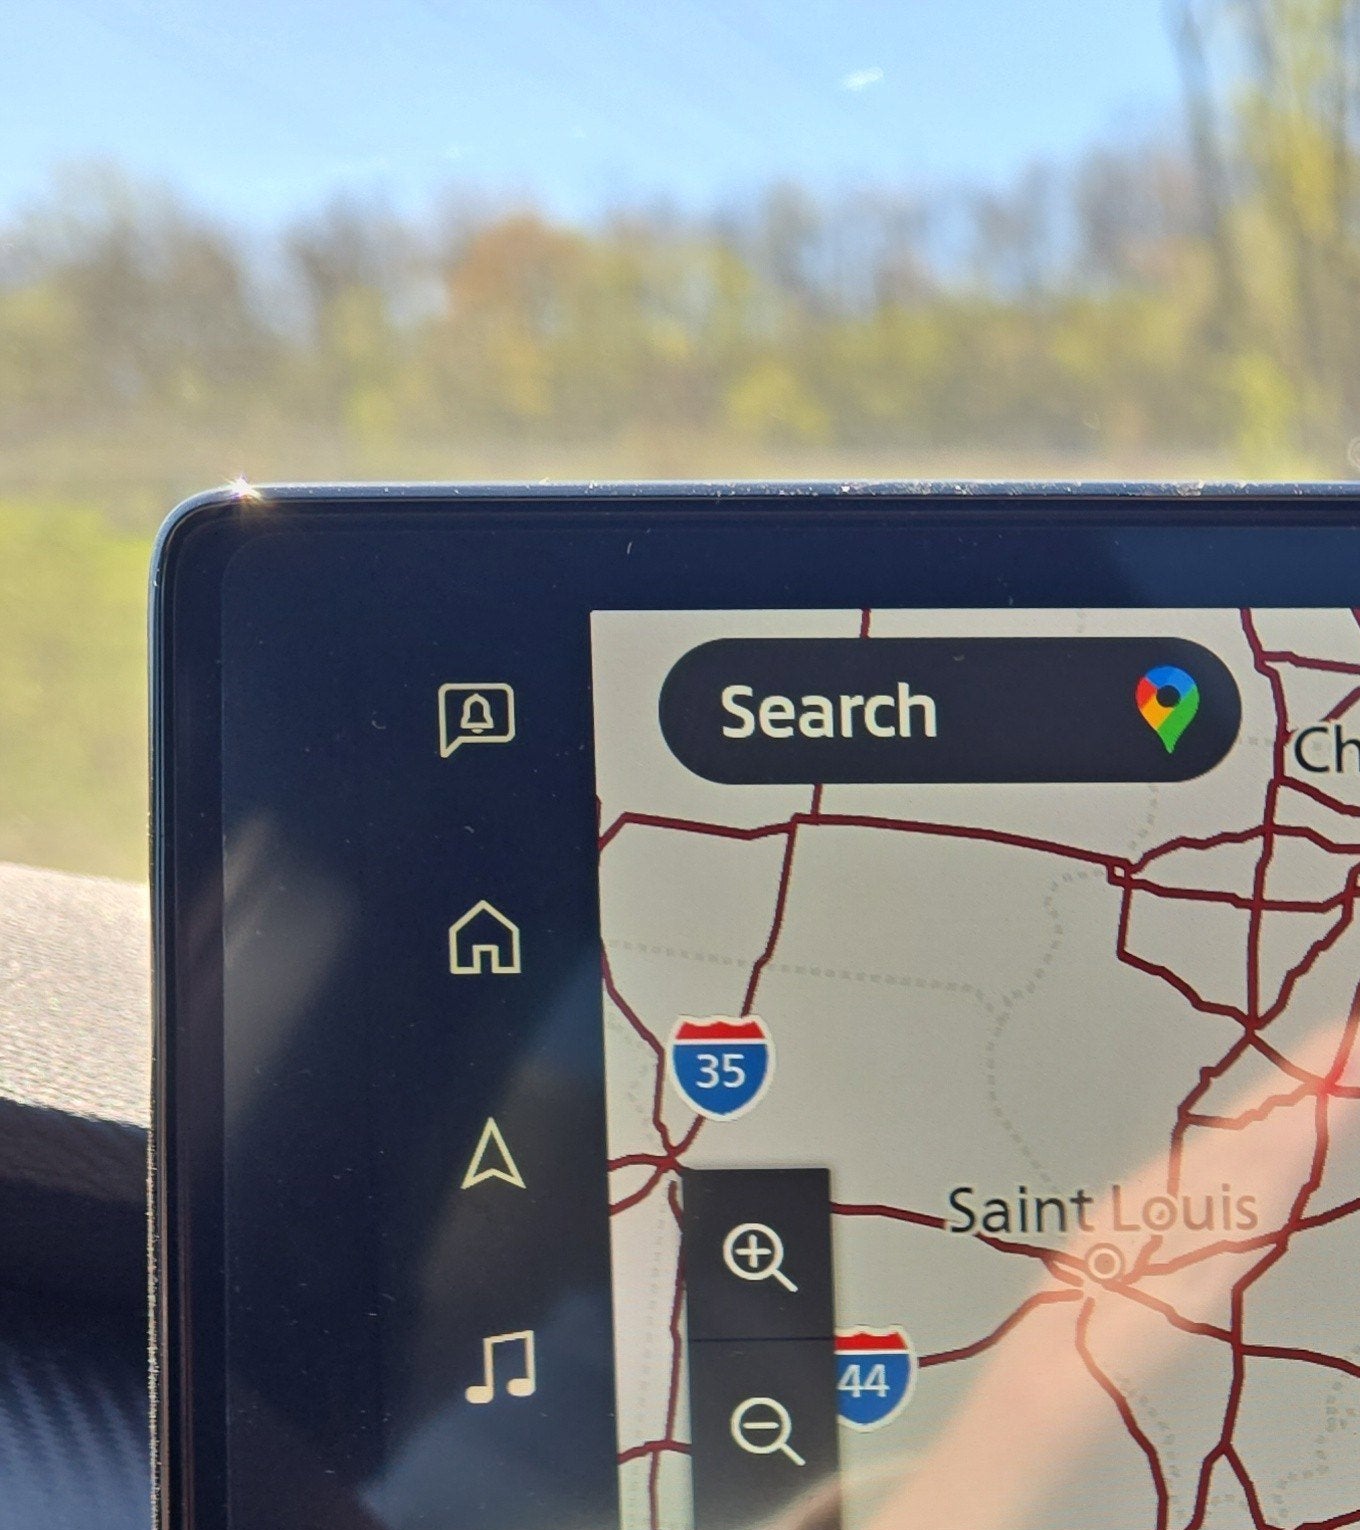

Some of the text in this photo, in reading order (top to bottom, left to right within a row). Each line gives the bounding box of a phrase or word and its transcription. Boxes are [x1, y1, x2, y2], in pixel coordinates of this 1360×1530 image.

[720, 683, 938, 738] Search
[696, 1054, 746, 1089] 35
[948, 1184, 1259, 1233] Saint Louis
[837, 1363, 890, 1398] 44
